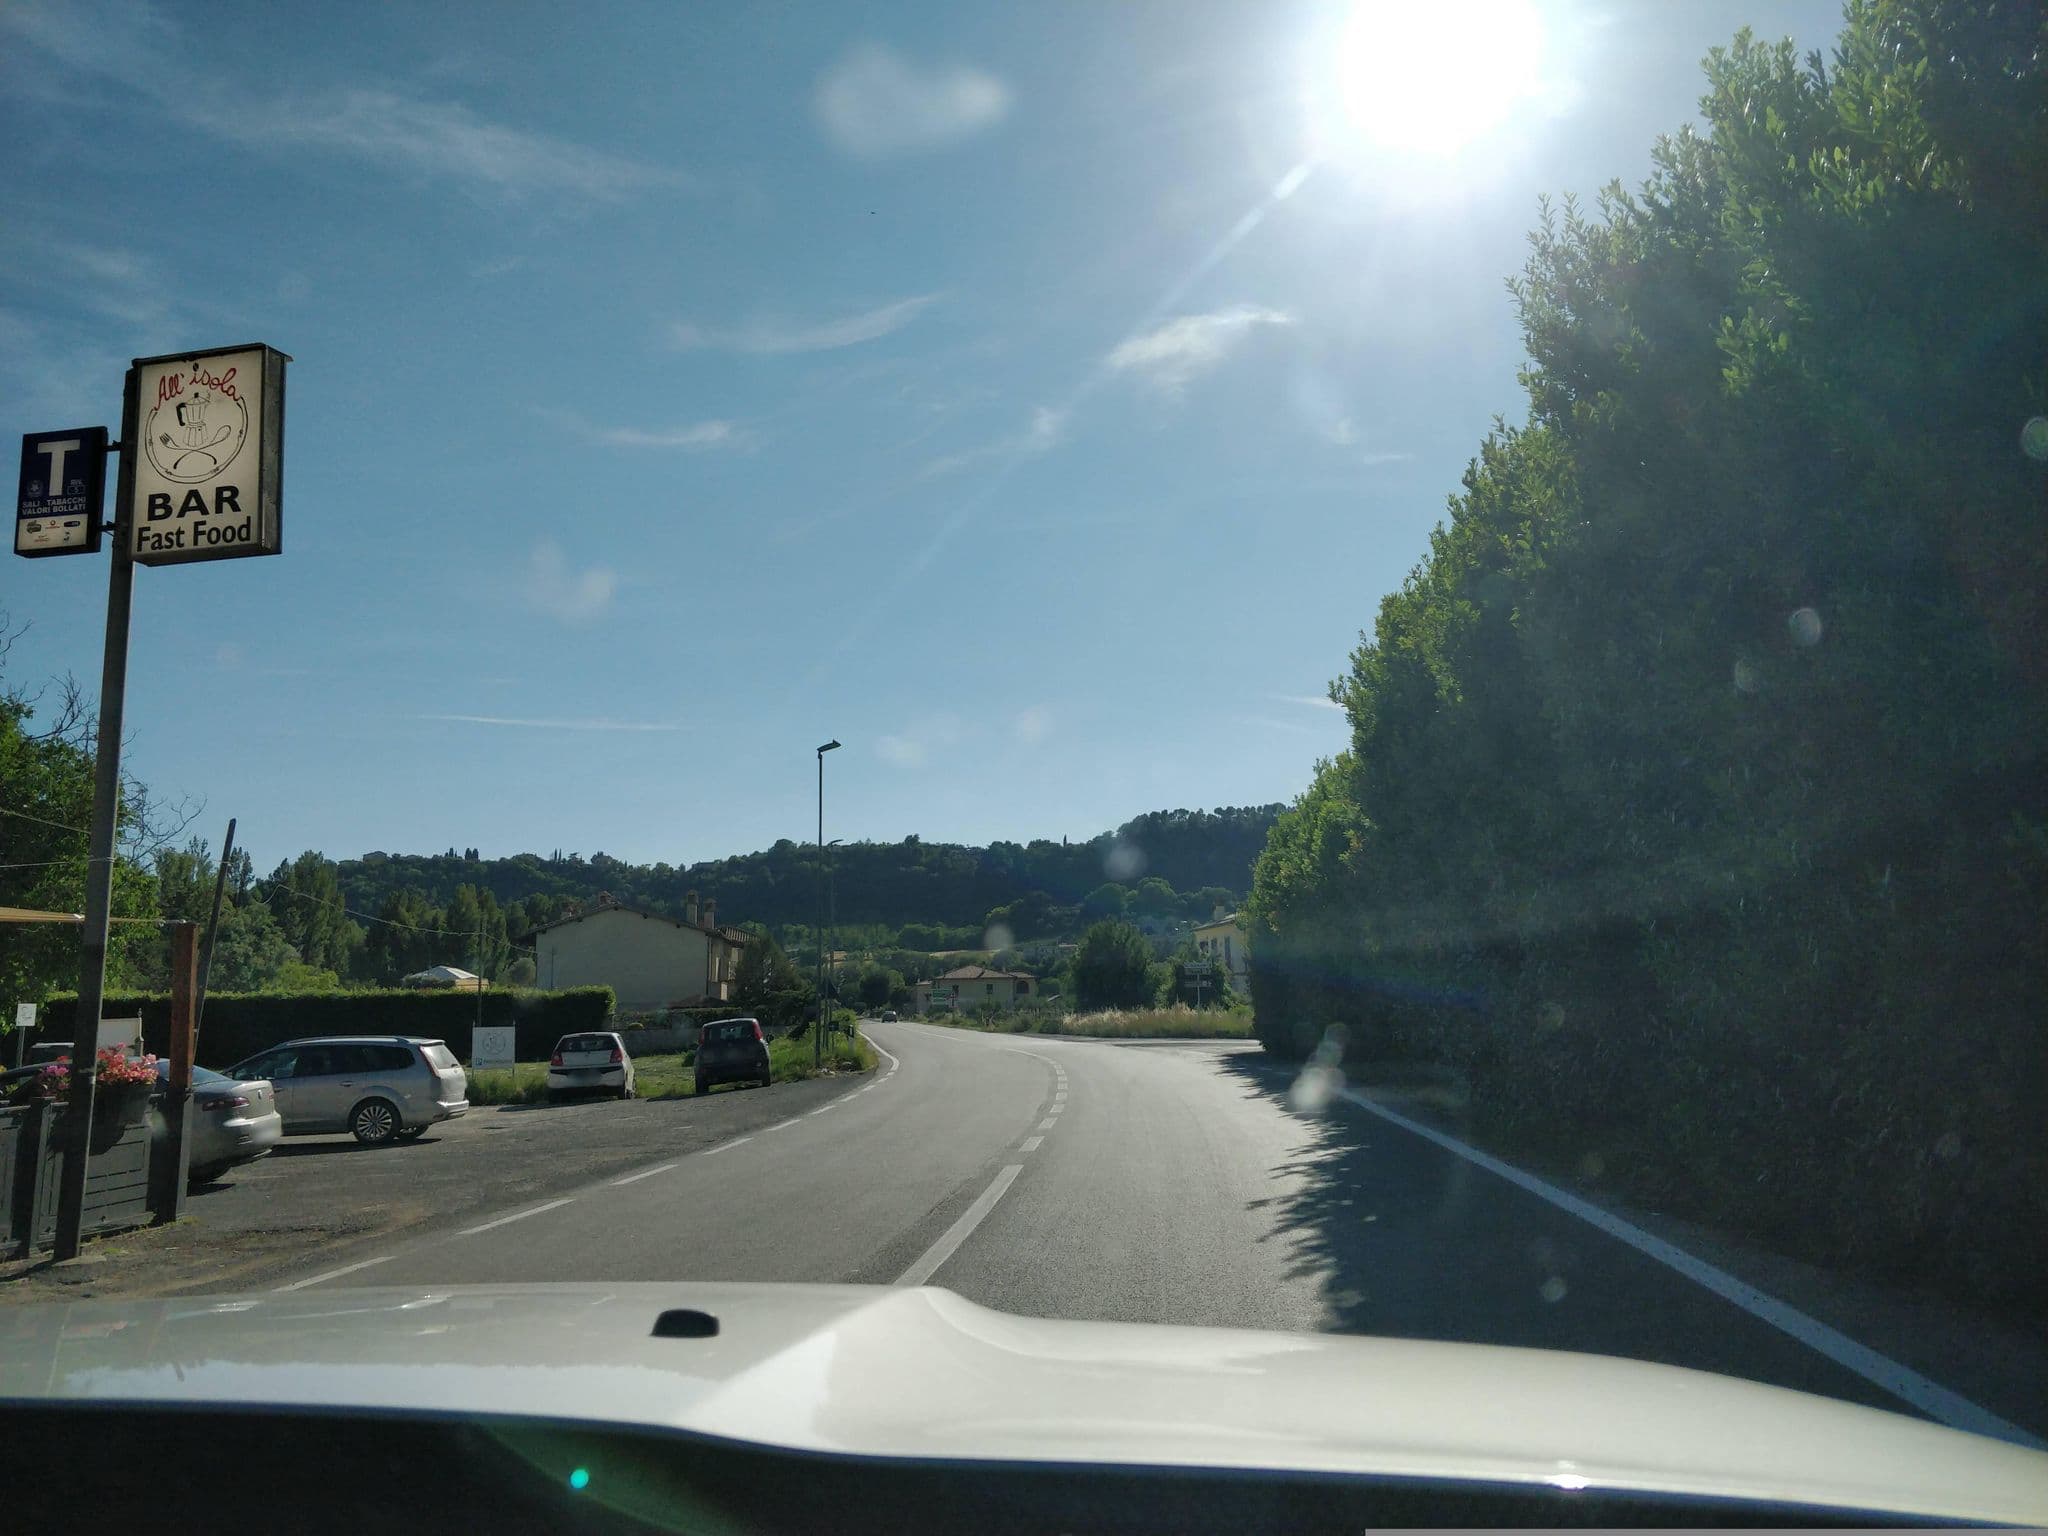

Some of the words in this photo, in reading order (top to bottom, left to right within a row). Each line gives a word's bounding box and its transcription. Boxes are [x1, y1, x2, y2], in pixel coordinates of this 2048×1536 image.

[189, 363, 241, 402] isola
[37, 439, 80, 496] T
[21, 507, 51, 516] VALORI
[52, 503, 86, 513] BOLLATI
[47, 496, 86, 506] TABACCHI
[147, 485, 241, 521] BAR
[136, 525, 184, 552] Fast
[193, 516, 251, 547] Food
